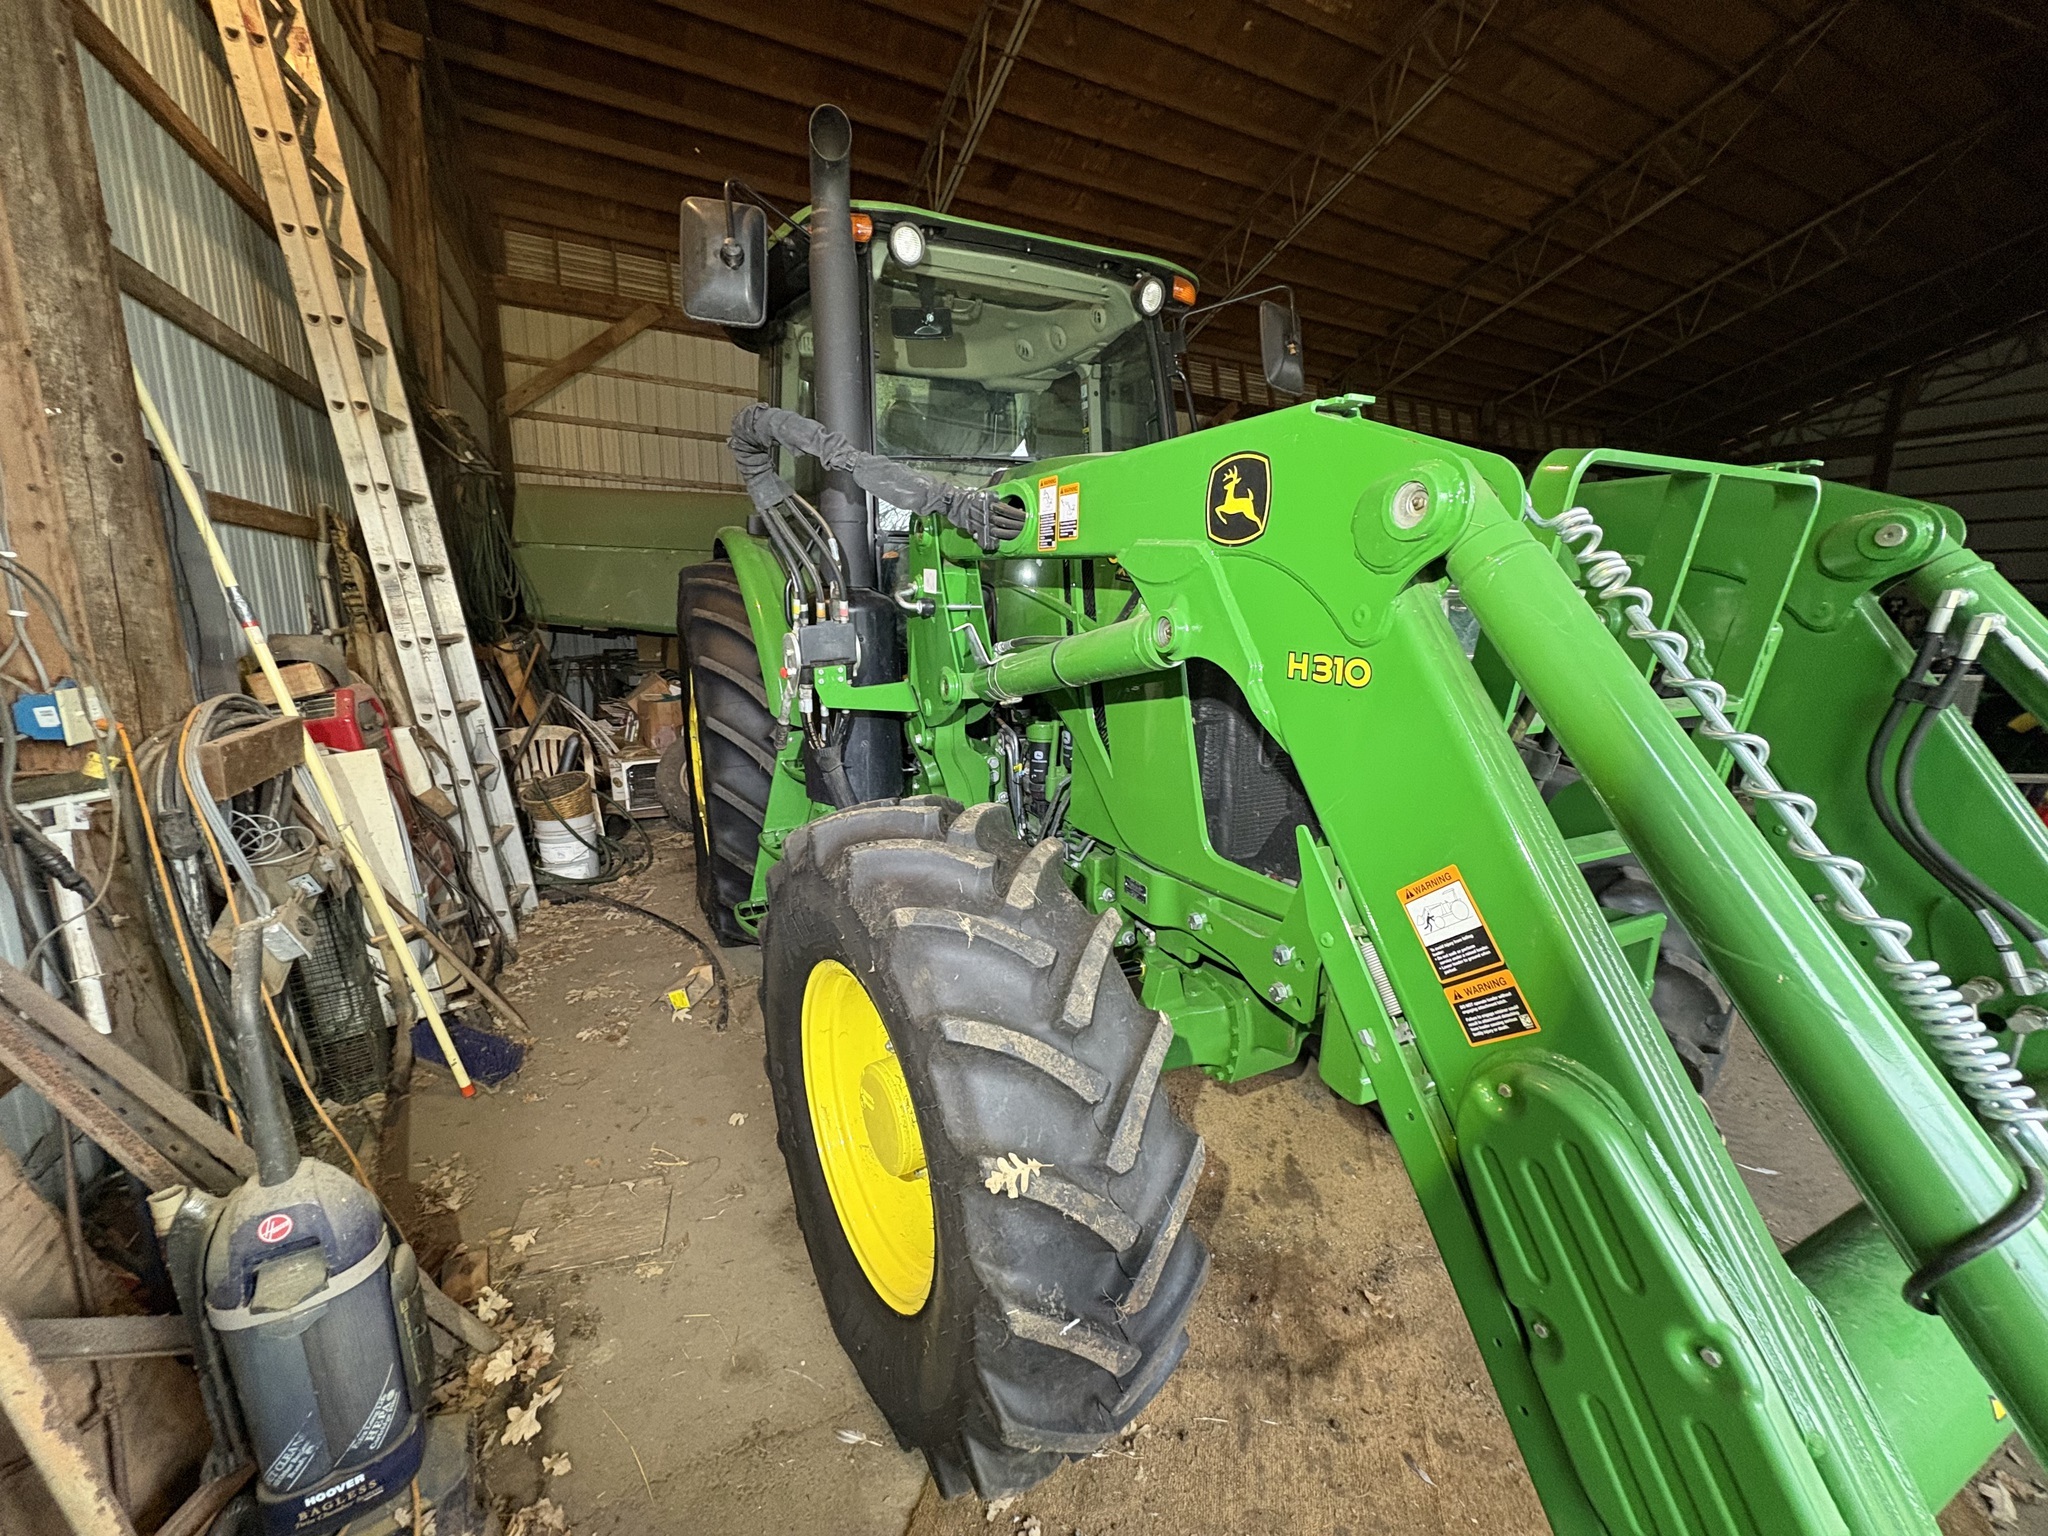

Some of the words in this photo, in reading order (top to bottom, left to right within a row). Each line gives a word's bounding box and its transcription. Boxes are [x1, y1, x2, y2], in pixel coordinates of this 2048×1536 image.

[1287, 651, 1372, 688] H310
[1413, 872, 1452, 895] WARNING
[1463, 977, 1507, 996] WARNING
[365, 1402, 392, 1442] HEPA
[297, 1479, 377, 1522] BAGLESS
[305, 1473, 365, 1507] HOOVER
